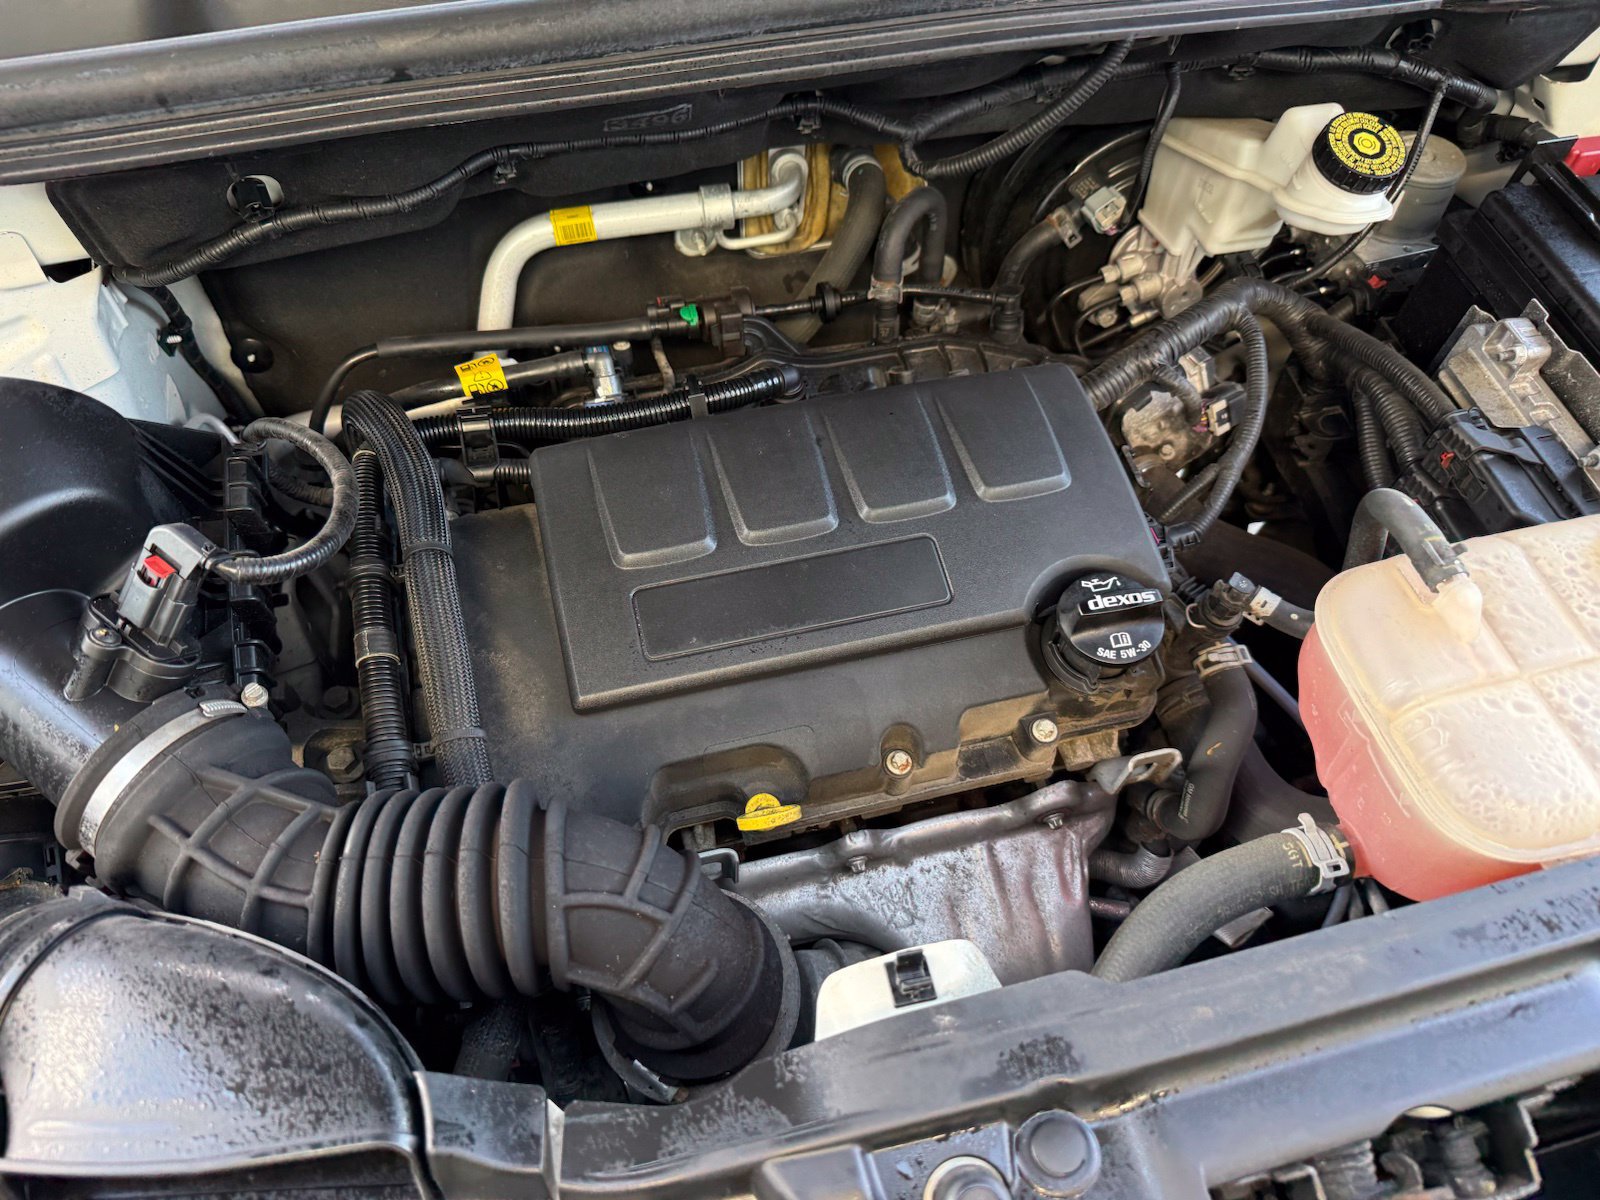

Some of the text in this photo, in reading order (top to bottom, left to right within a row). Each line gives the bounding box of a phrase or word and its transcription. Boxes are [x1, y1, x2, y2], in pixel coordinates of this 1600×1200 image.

[1087, 588, 1156, 611] dexos
[1096, 640, 1152, 659] SAE 5W-30
